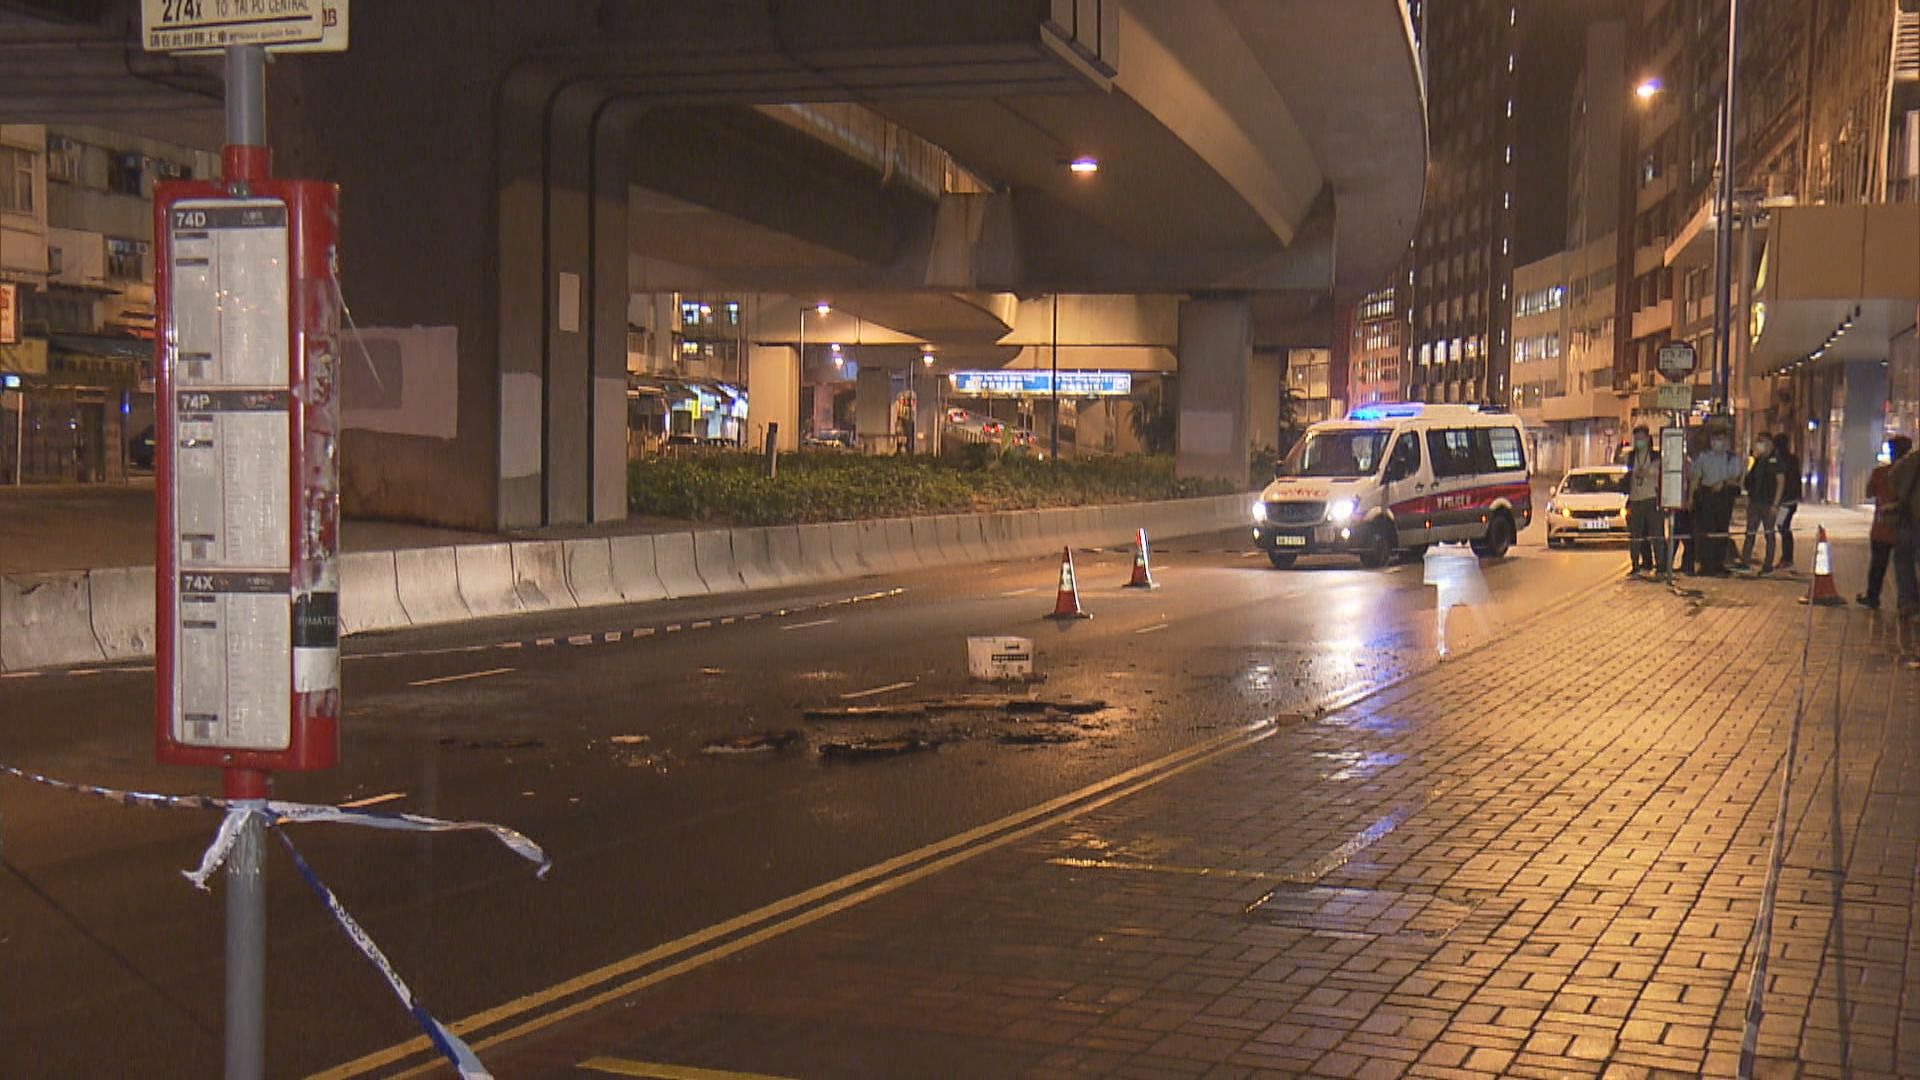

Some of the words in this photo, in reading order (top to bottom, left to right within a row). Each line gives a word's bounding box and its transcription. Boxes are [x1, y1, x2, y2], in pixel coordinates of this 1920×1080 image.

[234, 0, 248, 15] TAI
[176, 212, 206, 227] 74D
[181, 394, 211, 409] 74P
[185, 575, 214, 591] 74X
